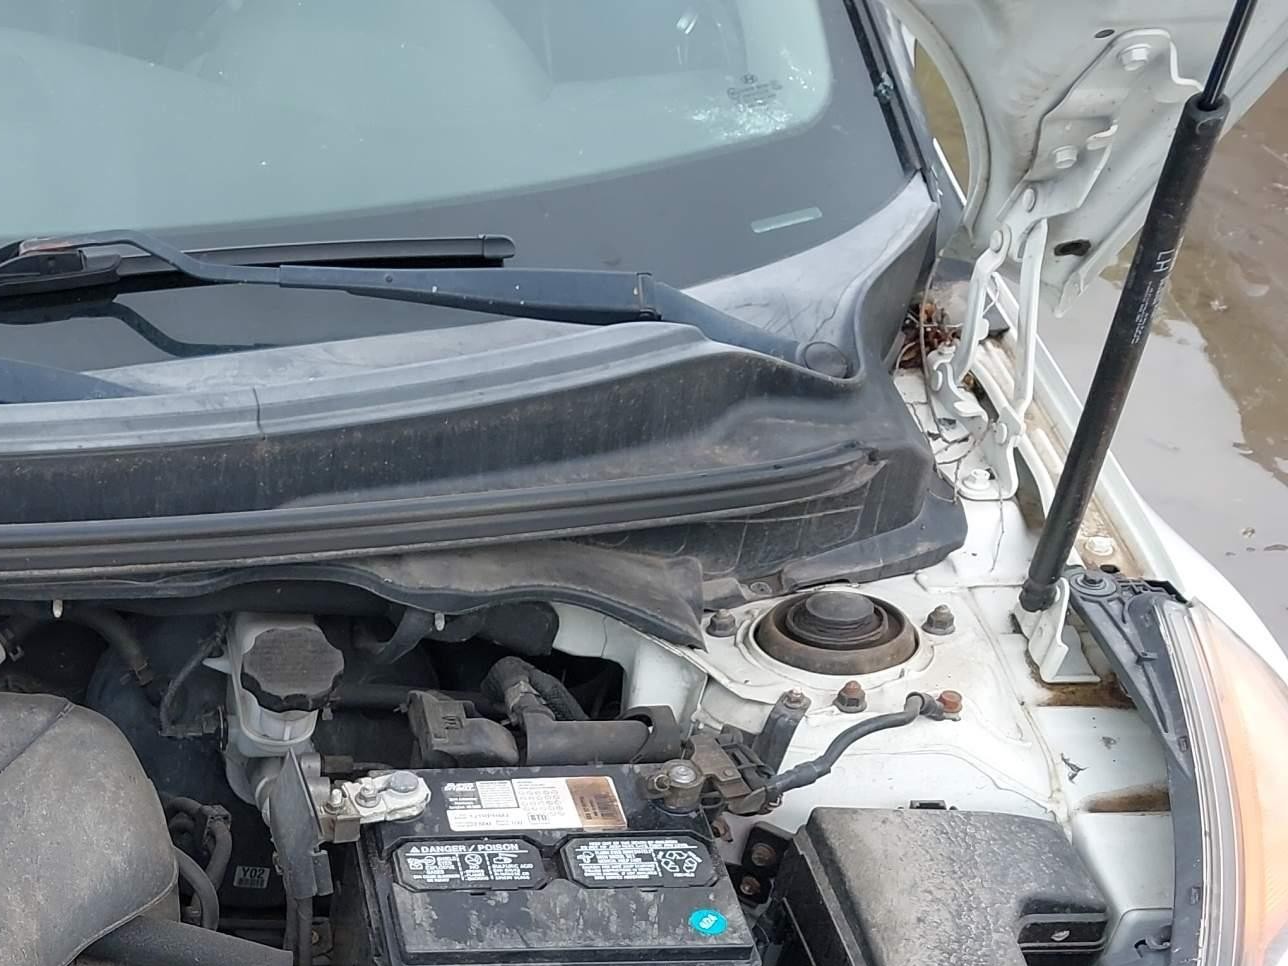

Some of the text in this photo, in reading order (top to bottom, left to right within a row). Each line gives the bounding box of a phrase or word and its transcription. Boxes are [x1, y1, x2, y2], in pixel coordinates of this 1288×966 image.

[1153, 249, 1175, 272] LH
[420, 845, 466, 853] DANGER
[477, 843, 519, 852] POISON
[242, 867, 264, 879] Y02
